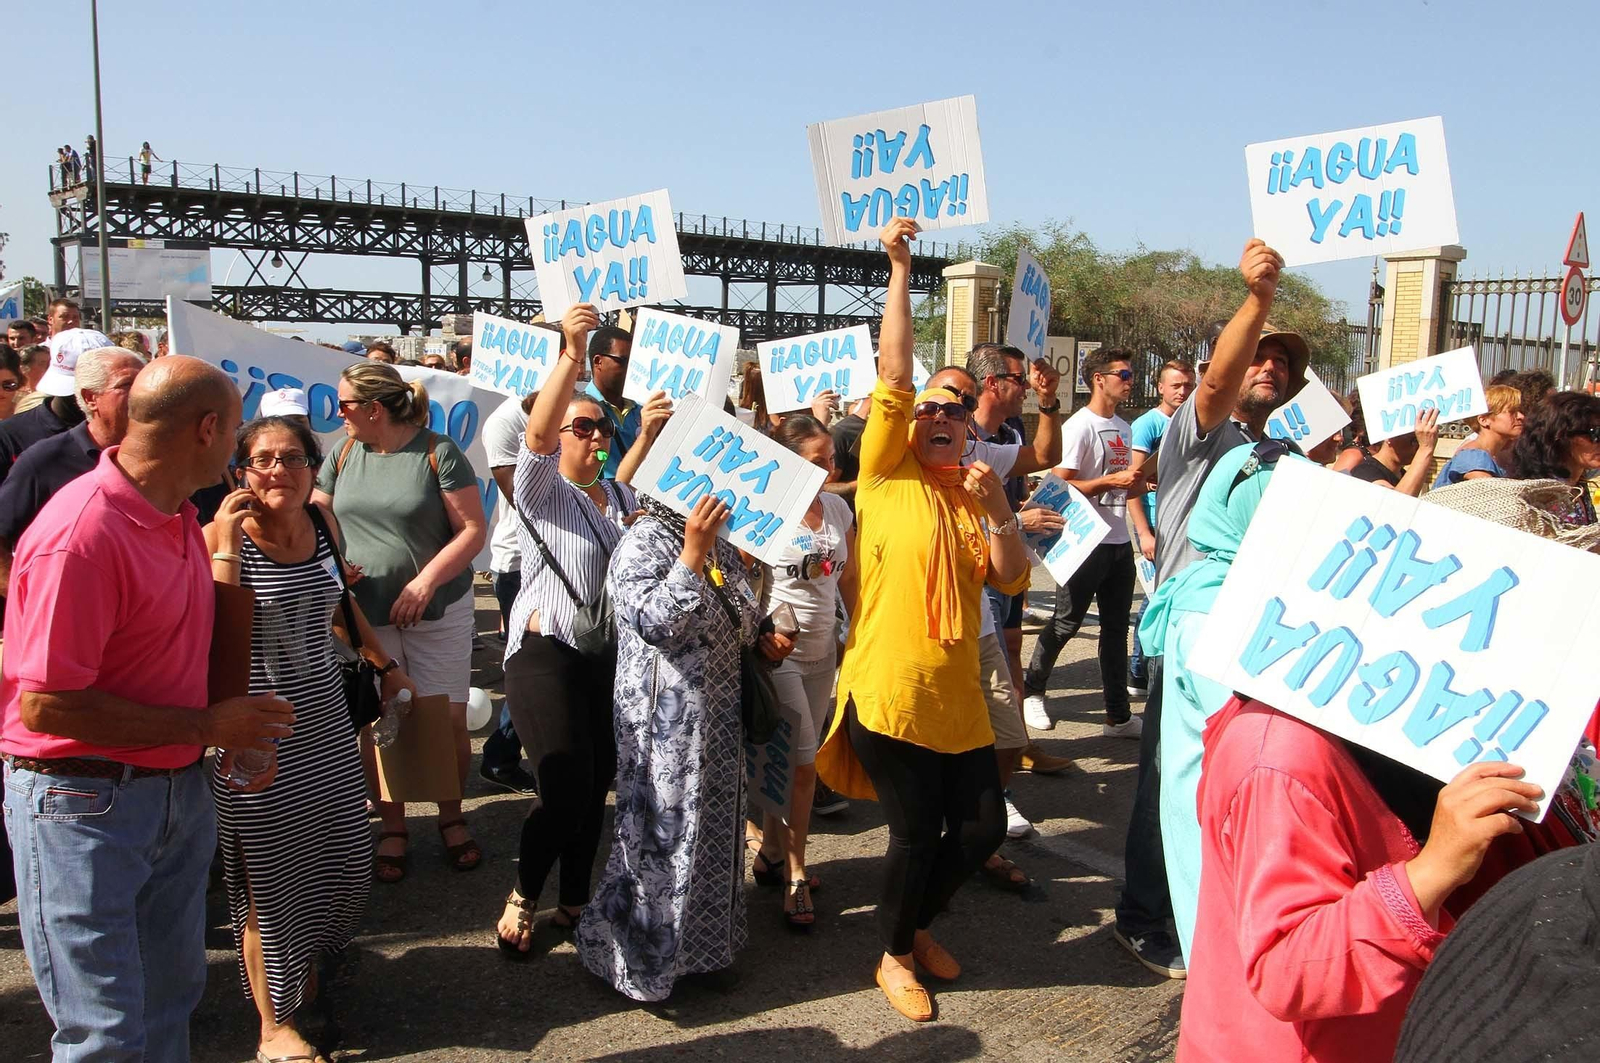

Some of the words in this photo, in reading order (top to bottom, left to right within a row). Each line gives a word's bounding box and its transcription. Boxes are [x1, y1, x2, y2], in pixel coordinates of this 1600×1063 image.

[851, 123, 936, 180] YA!!
[1267, 132, 1420, 195] ¡¡AGUA
[841, 173, 969, 233] ¡¡AGUA
[1306, 188, 1406, 245] YA!!
[543, 204, 657, 264] ¡¡AGUA
[572, 255, 648, 303] YA!!
[1568, 287, 1581, 306] 30
[480, 322, 548, 366] ¡¡AGUA
[639, 317, 721, 366] ¡¡AGUA
[770, 334, 858, 374] ¡¡AGUA
[493, 358, 538, 397] YA!!
[646, 358, 704, 400] YA!!
[793, 368, 851, 404] YA!!
[1387, 365, 1446, 403] YA!!
[1268, 402, 1311, 440] A!!
[692, 425, 780, 495] YA!!
[1109, 456, 1129, 466] adida
[1307, 515, 1520, 653] YA!!
[1238, 596, 1551, 767] ¡¡AGUA
